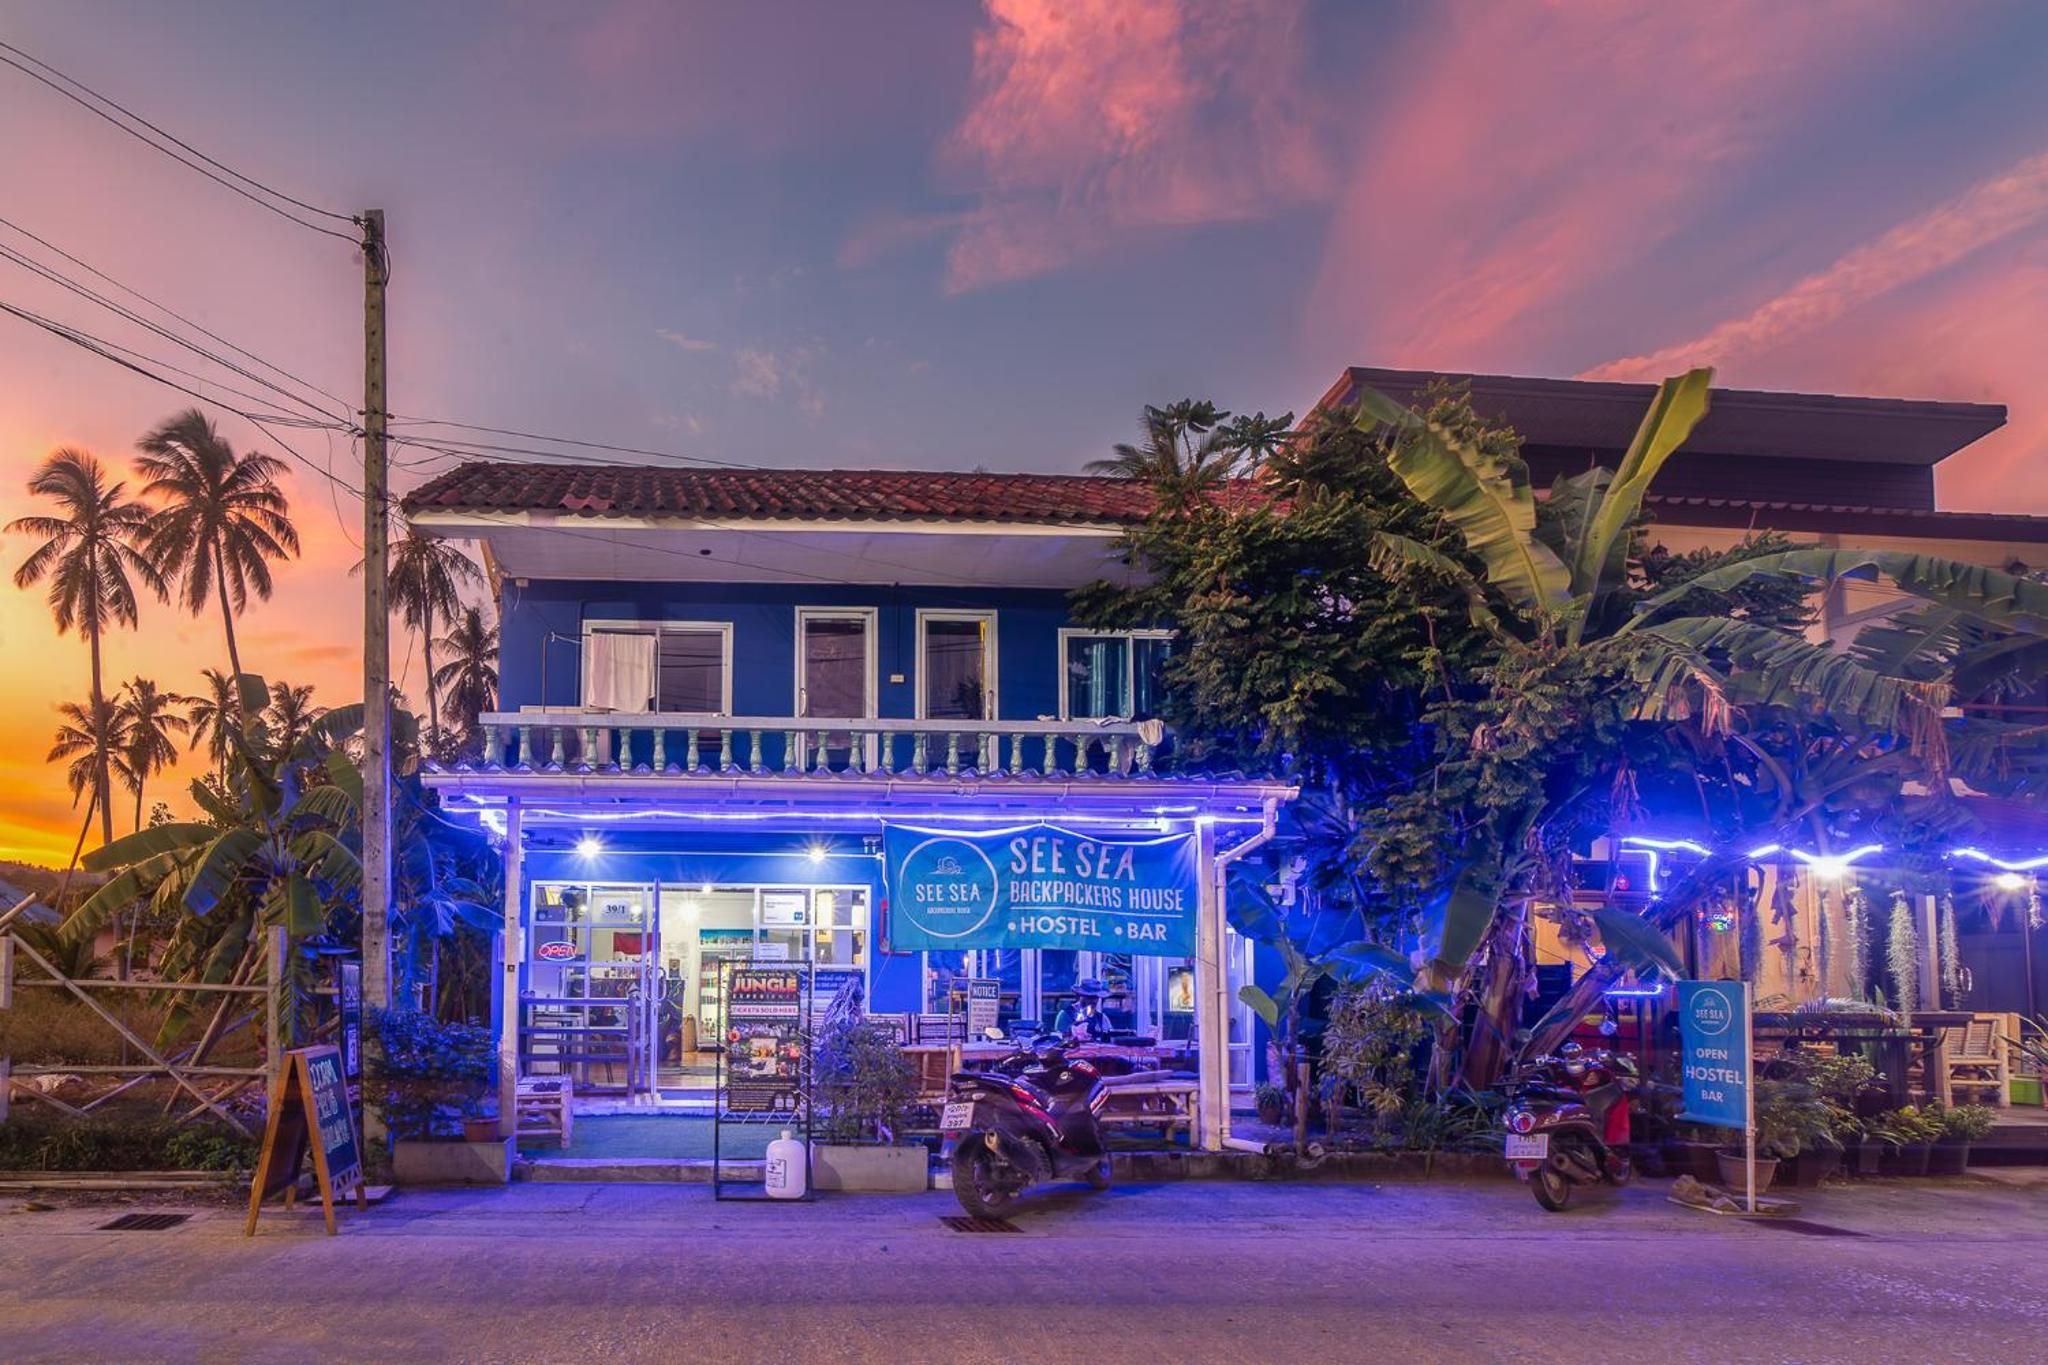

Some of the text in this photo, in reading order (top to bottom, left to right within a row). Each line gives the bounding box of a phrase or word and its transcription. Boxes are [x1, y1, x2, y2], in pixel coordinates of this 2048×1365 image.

[1009, 837, 1136, 881] SEE SEA
[915, 882, 981, 902] SEE SEA
[1010, 880, 1184, 911] BACKPACKERS HOUSE
[605, 904, 626, 914] 39/1
[1020, 915, 1168, 941] HOSTEL BAR
[539, 945, 577, 957] OPEN
[733, 977, 797, 992] JUNGLE
[973, 986, 996, 998] NOTICE
[1695, 1009, 1724, 1020] SEE SEA
[1696, 1047, 1728, 1060] OPEN
[1685, 1065, 1744, 1085] HOSTEL
[1701, 1089, 1724, 1103] BAR
